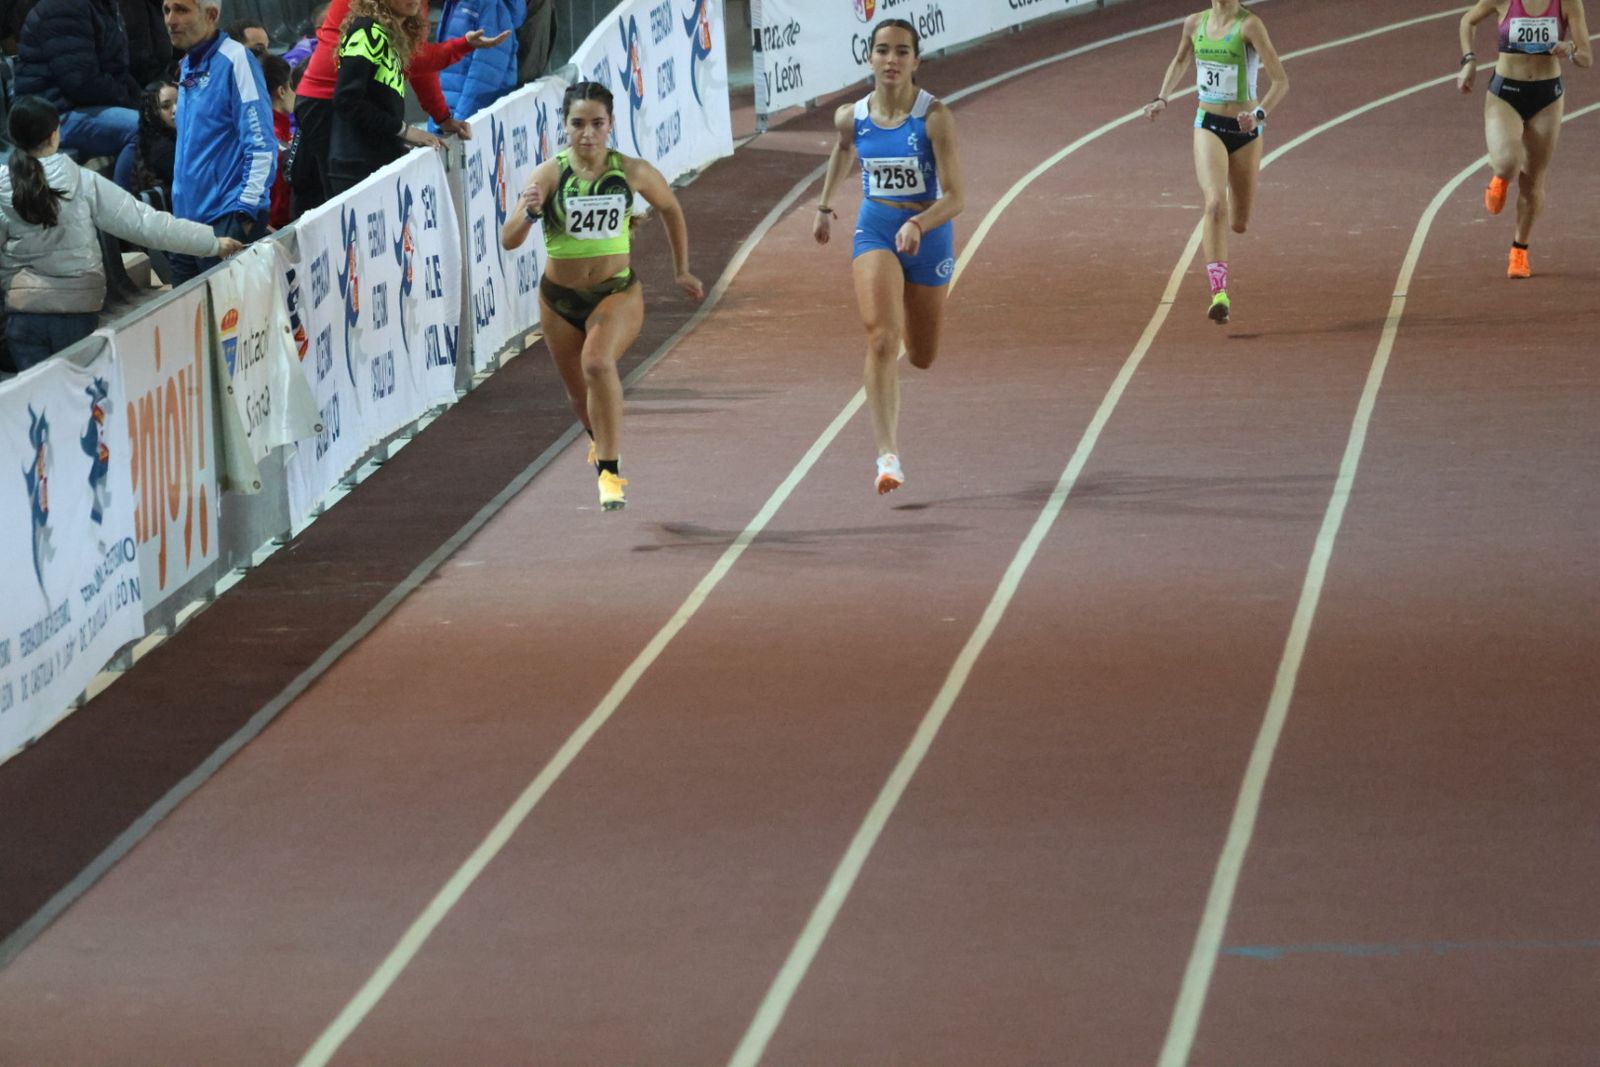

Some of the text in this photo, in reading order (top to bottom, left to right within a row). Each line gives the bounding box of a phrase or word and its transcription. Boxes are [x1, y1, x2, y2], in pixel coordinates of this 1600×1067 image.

[1517, 27, 1550, 42] 2016
[775, 57, 803, 94] León
[1206, 70, 1220, 87] 31
[873, 167, 918, 190] 1258
[570, 208, 619, 233] 2478
